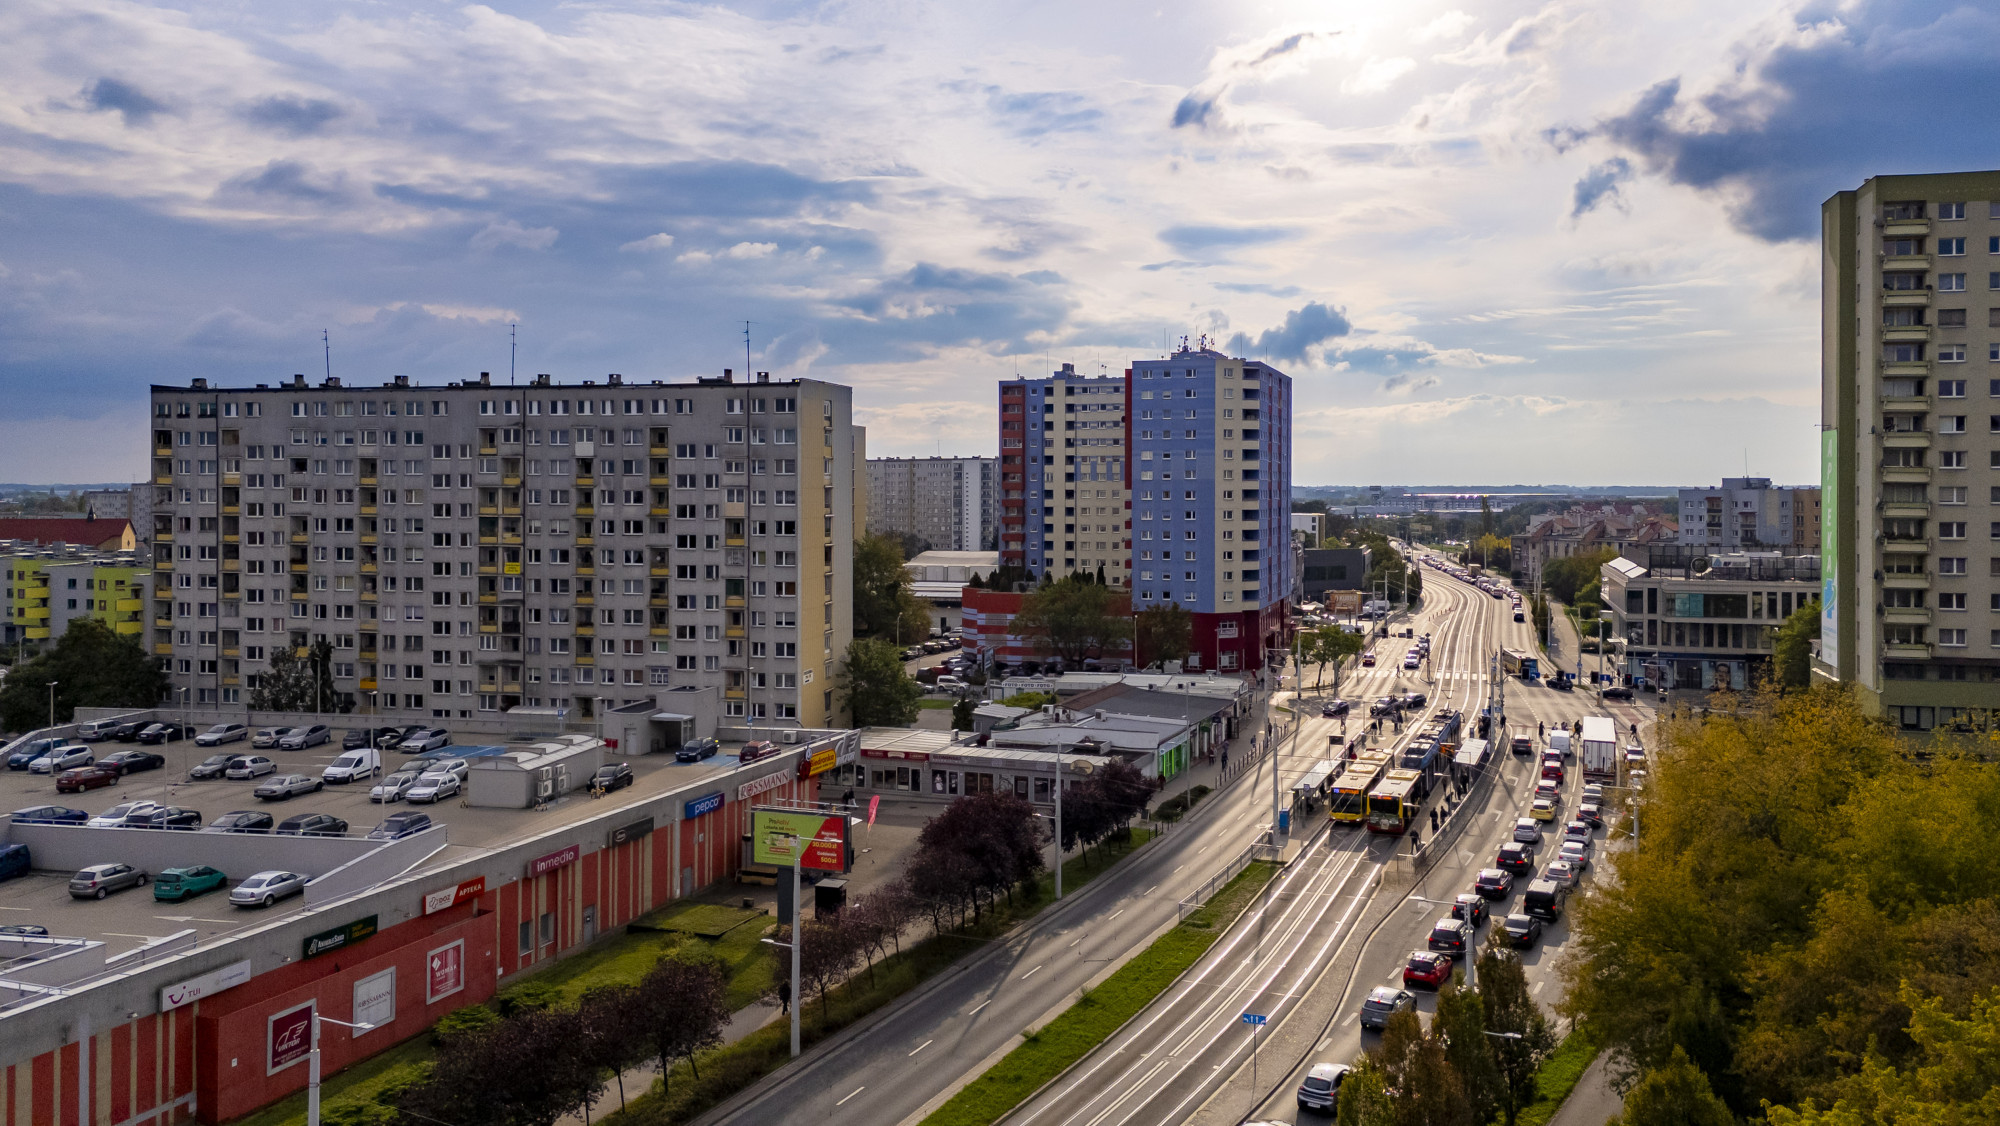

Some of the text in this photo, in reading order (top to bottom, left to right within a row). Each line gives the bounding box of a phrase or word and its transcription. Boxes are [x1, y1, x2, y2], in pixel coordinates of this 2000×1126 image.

[741, 771, 789, 799] ROSSMANN
[695, 798, 719, 815] pepco
[537, 851, 574, 872] inmedio
[458, 883, 482, 897] APTEKA
[188, 987, 201, 997] TUI
